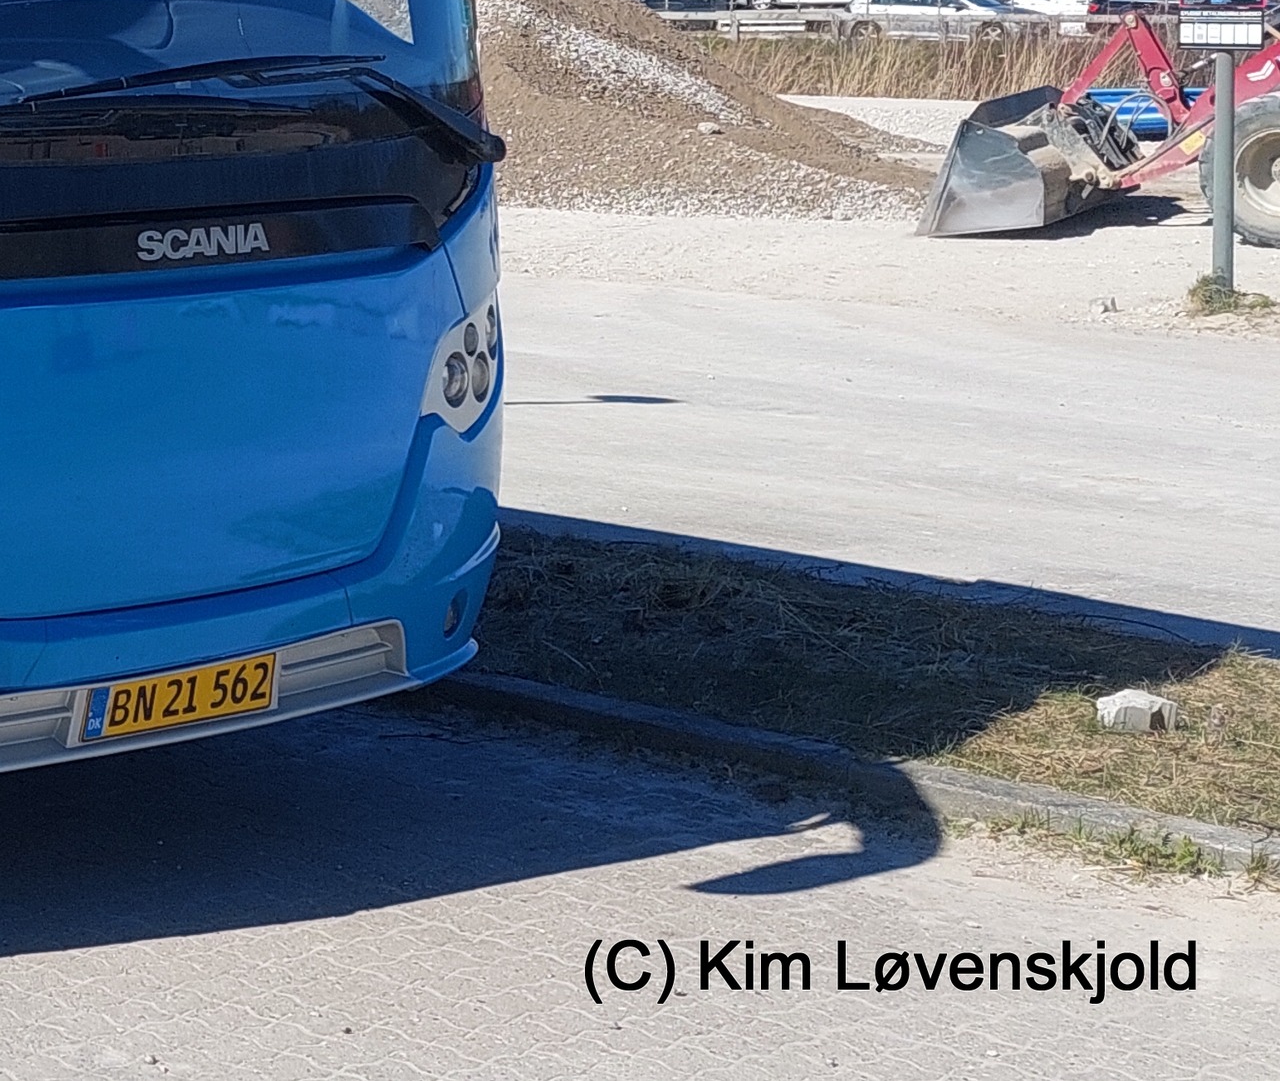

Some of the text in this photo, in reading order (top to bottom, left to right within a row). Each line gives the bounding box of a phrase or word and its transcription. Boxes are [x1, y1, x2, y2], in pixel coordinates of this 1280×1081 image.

[137, 223, 270, 260] SCANIA
[108, 662, 270, 728] BN 21 562
[87, 717, 101, 731] DK
